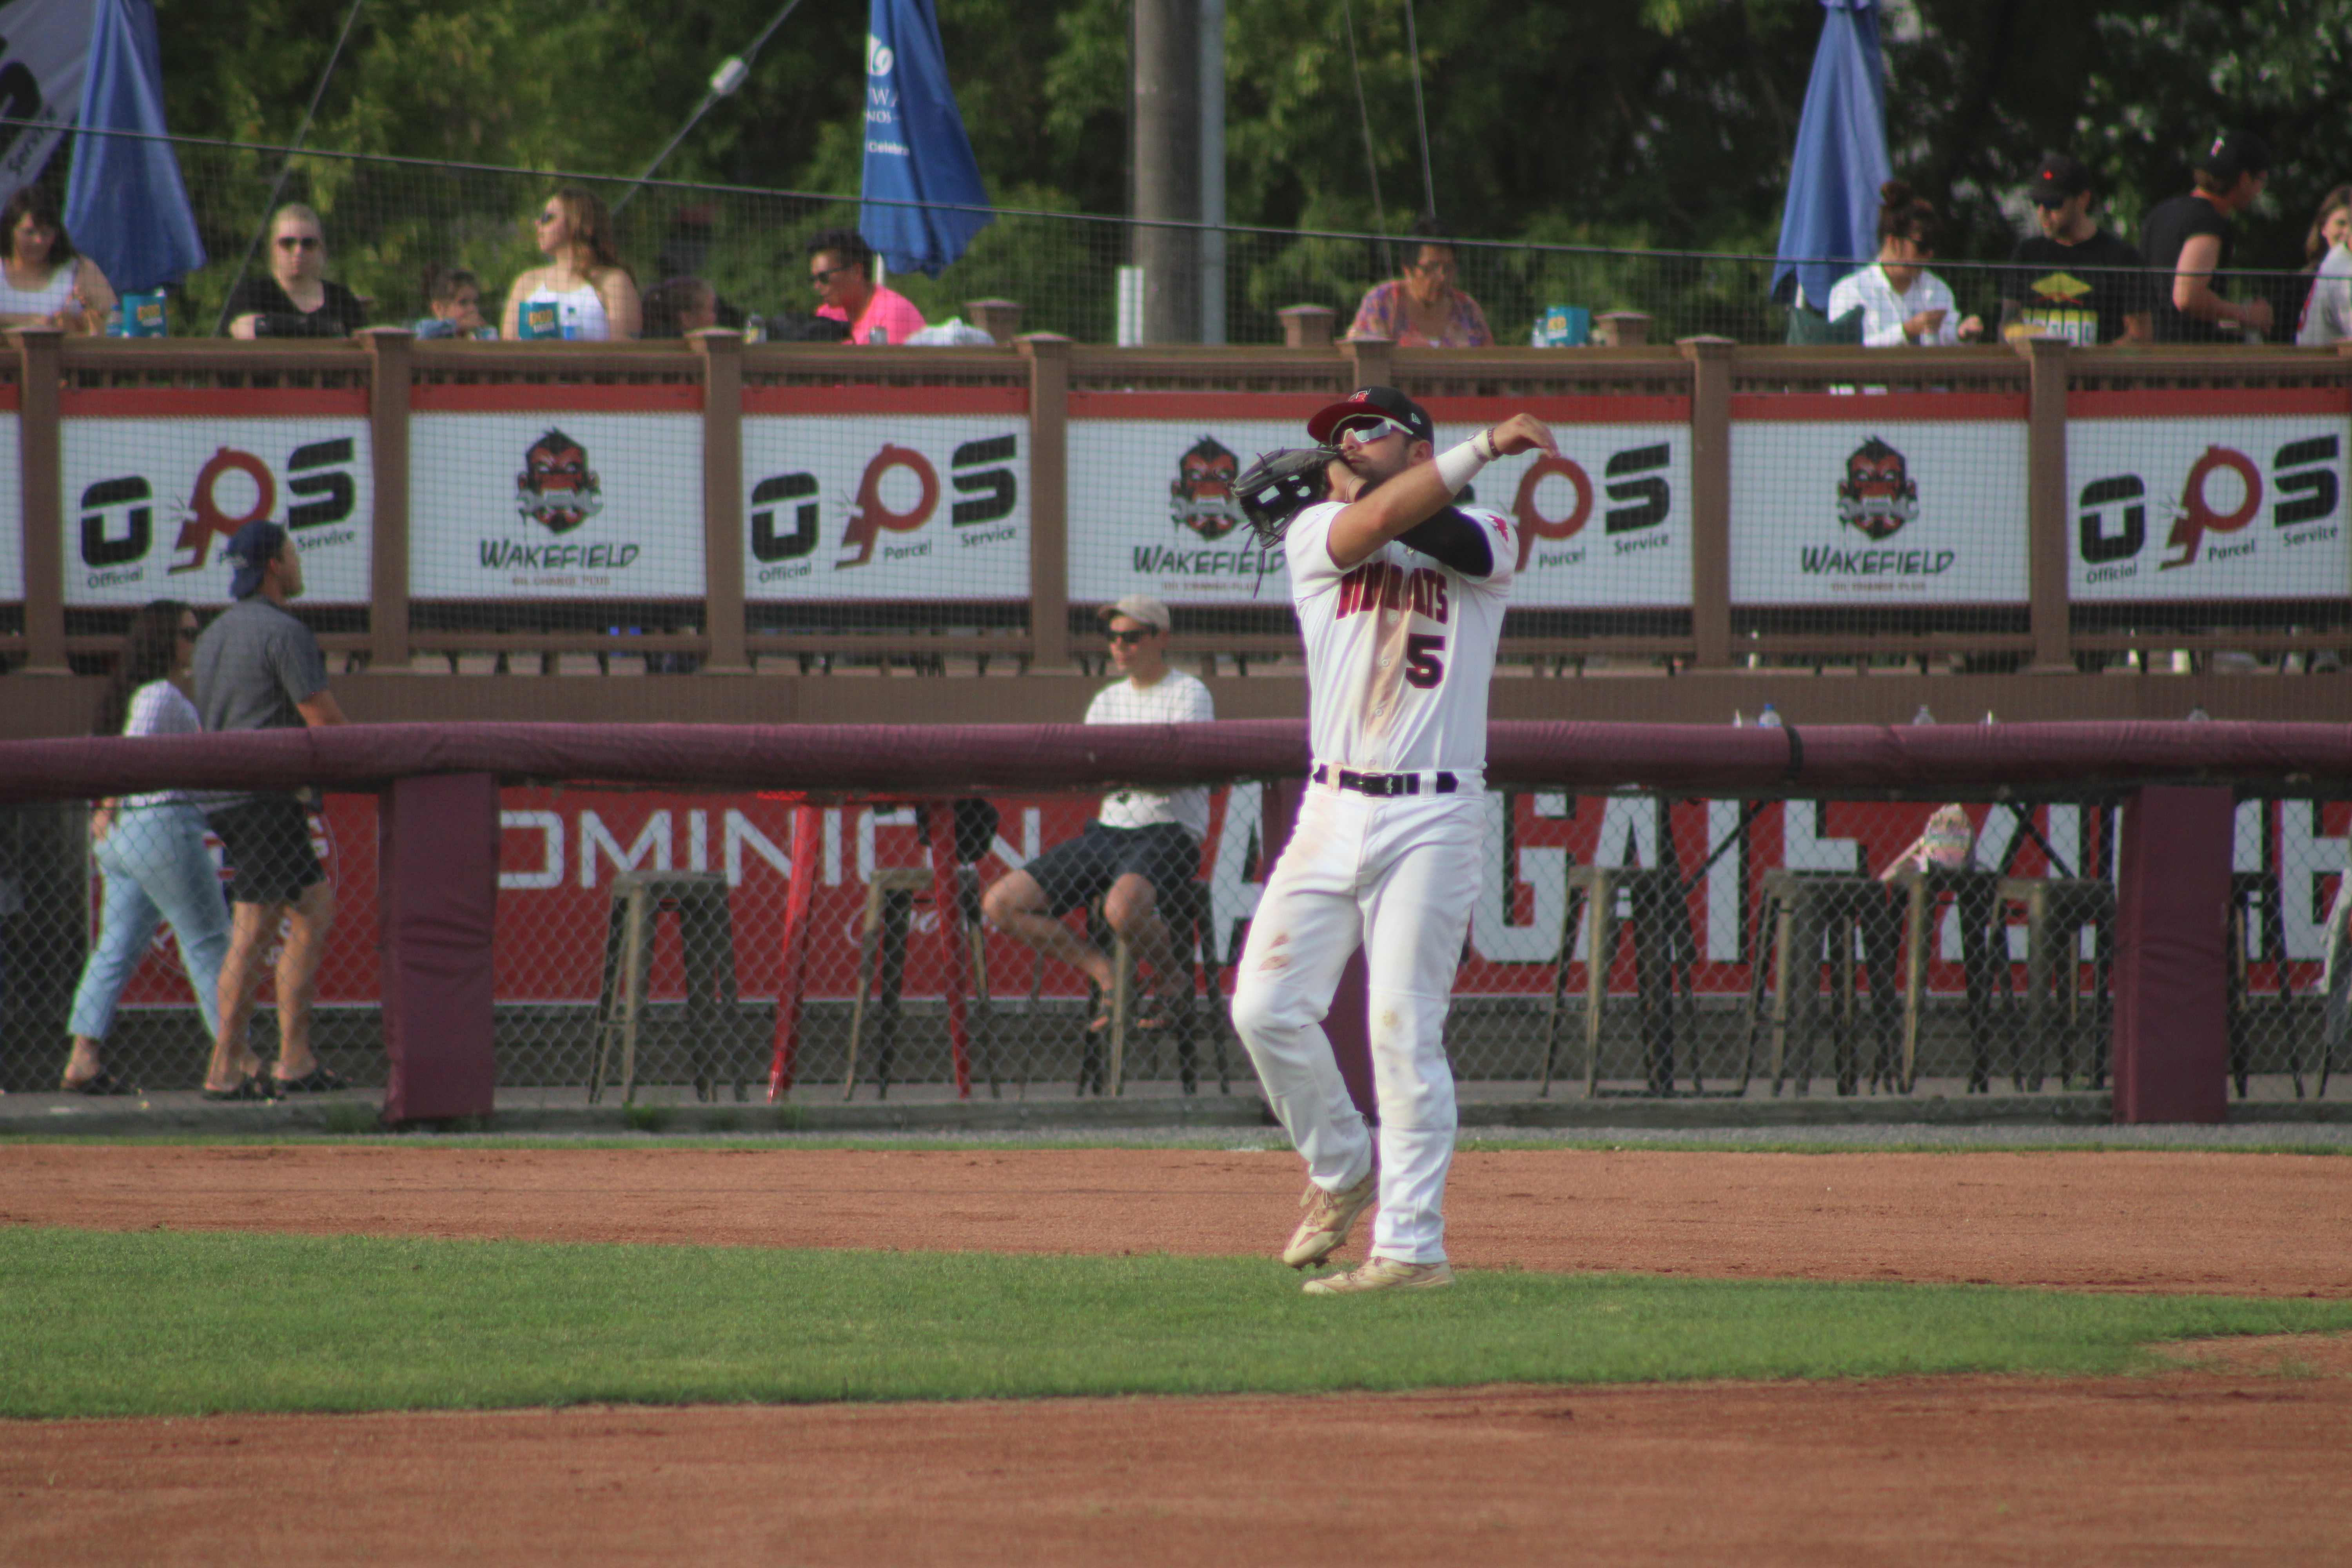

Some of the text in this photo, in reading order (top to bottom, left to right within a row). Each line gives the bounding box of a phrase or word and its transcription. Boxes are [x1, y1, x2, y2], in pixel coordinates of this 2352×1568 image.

[88, 529, 355, 588] Official Service
[481, 538, 640, 569] WAKEFIELD
[759, 526, 1016, 584] Official Parcel Service
[1133, 545, 1286, 575] WAKEFIELD
[1539, 533, 1670, 568] Parcel Service
[1802, 545, 1955, 575] WAKEFIELD
[2086, 524, 2338, 584] Official Parcel Service
[1406, 633, 1446, 689] 5
